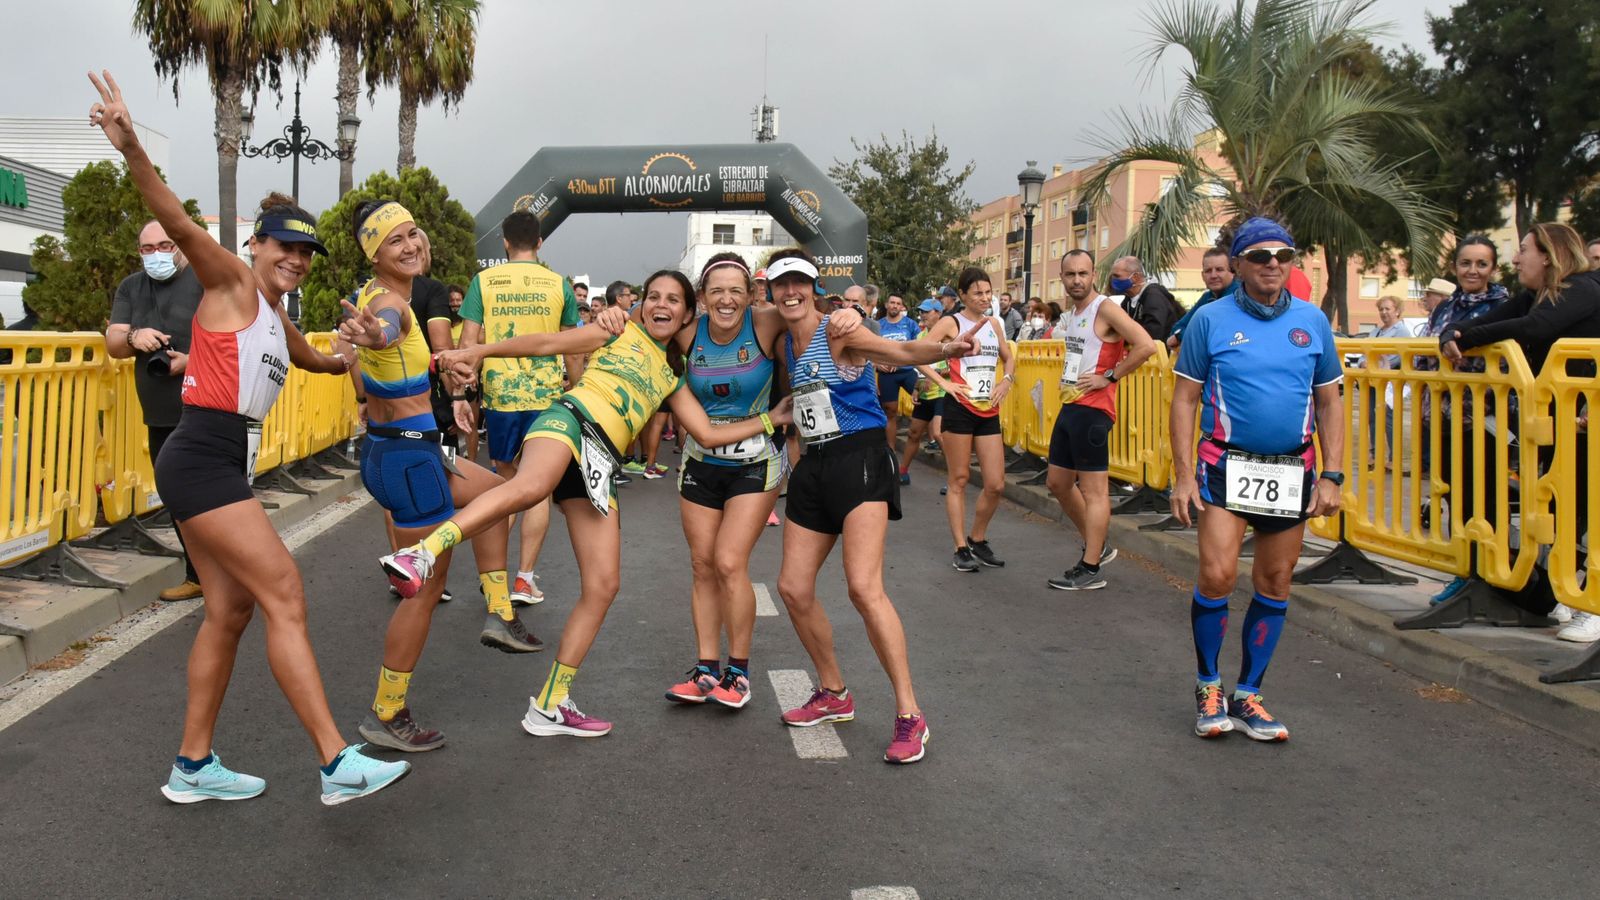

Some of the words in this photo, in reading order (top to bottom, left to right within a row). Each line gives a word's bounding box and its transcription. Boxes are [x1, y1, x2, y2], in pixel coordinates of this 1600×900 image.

[719, 165, 757, 179] ESTRECHO
[759, 165, 769, 179] DE
[600, 177, 616, 196] BTT
[624, 173, 711, 197] ALCORNOCALES
[722, 179, 765, 193] GIBRALTAR
[722, 193, 735, 203] LOS
[736, 192, 766, 203] BARRIOS
[781, 188, 822, 226] ALCORNOCALES
[825, 254, 863, 265] BARRIOS
[819, 264, 853, 277] CÁDIZ
[496, 292, 547, 303] RUNNERS
[491, 302, 551, 317] BARREÑOS
[801, 408, 815, 430] 45
[1243, 463, 1285, 475] FRANCISCO
[1237, 476, 1279, 502] 278
